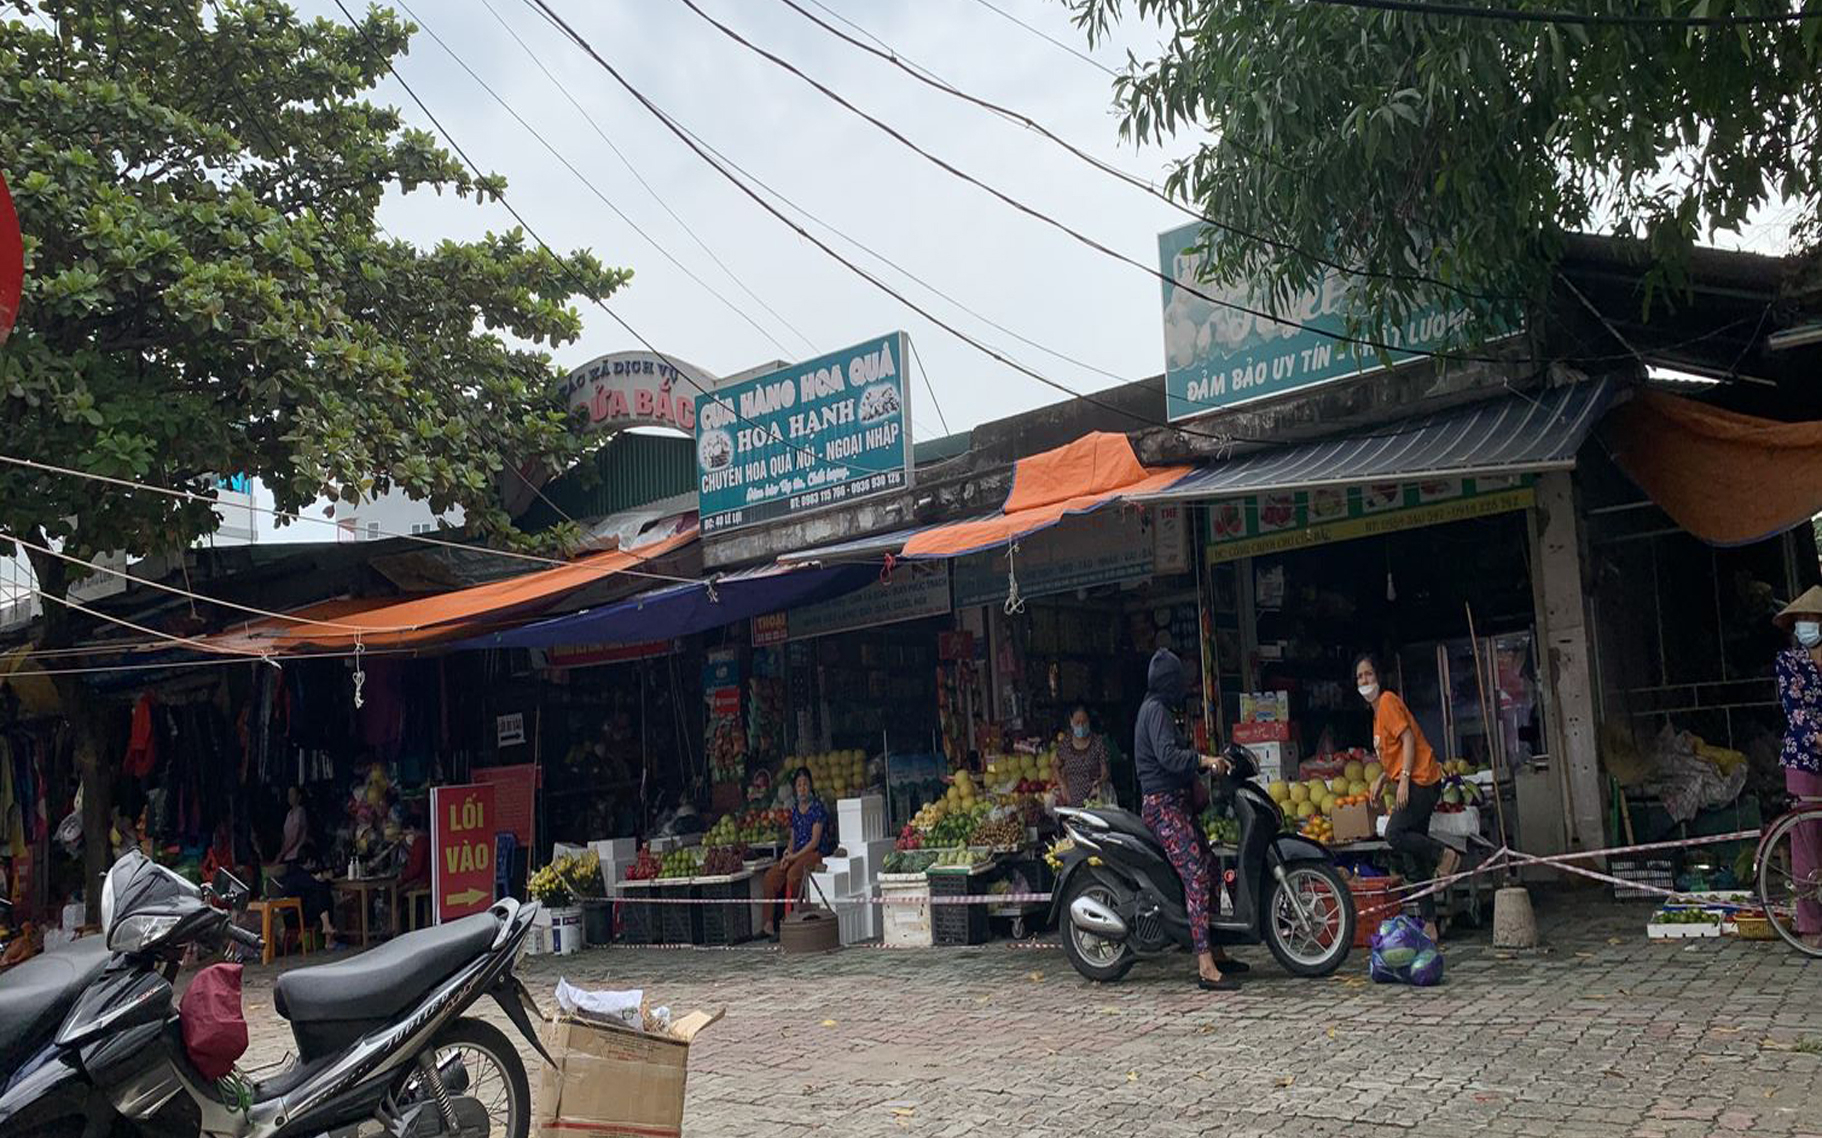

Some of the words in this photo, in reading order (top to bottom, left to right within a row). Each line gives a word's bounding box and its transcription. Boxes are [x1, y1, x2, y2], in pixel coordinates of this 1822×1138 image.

[589, 360, 610, 381] XÃ
[613, 361, 654, 377] DỊCH
[657, 362, 679, 384] VỤ
[800, 365, 846, 402] HOA
[849, 341, 896, 387] QUẢ
[1187, 369, 1226, 404] ĐẢM
[1232, 357, 1266, 388] BẢO
[1272, 357, 1296, 382] UY
[1301, 341, 1332, 375] TÍN
[634, 377, 696, 429] BẮC
[789, 399, 856, 439] HẠNH
[701, 466, 743, 494] CHUYÊN
[746, 459, 767, 482] HOA
[770, 447, 793, 476] QUẢ
[796, 444, 816, 471] NỘI
[826, 436, 863, 461] NGOẠI
[866, 421, 899, 451] NHẬP
[450, 793, 484, 832] LỐI
[445, 843, 489, 874] VÀO
